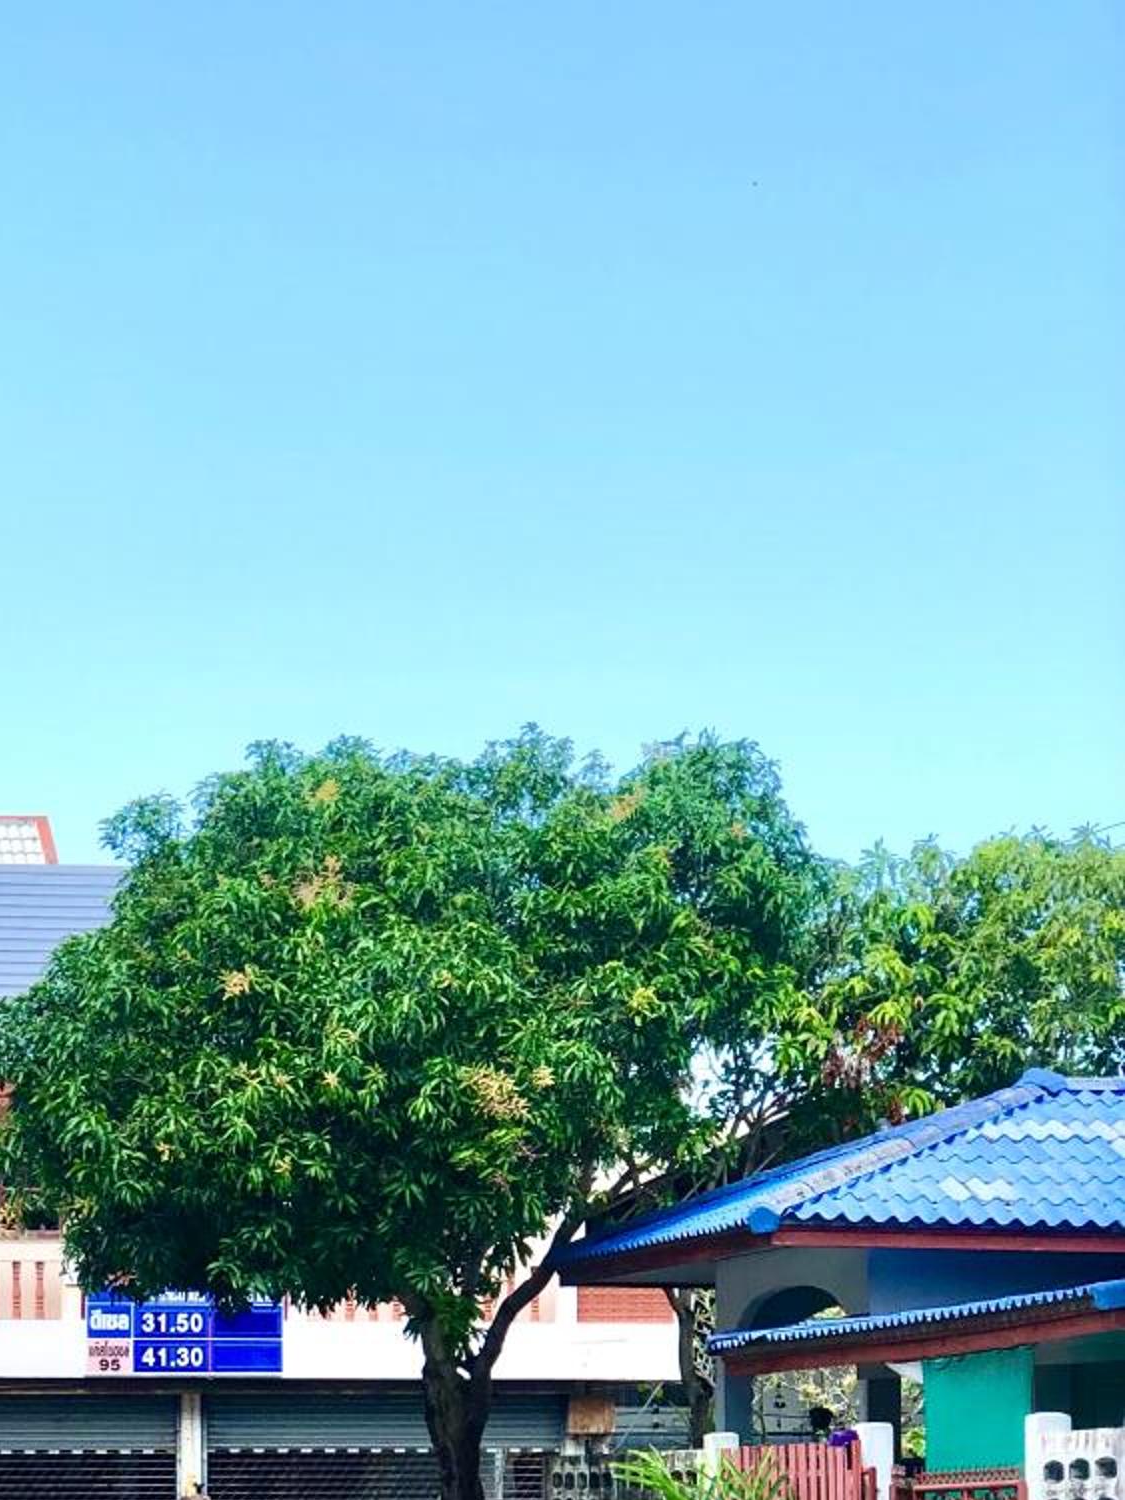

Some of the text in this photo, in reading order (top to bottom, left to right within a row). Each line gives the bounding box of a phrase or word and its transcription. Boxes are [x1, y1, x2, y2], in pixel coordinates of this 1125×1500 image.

[141, 1313, 204, 1333] 31.50
[98, 1359, 121, 1371] 95
[141, 1347, 204, 1367] 41.30
